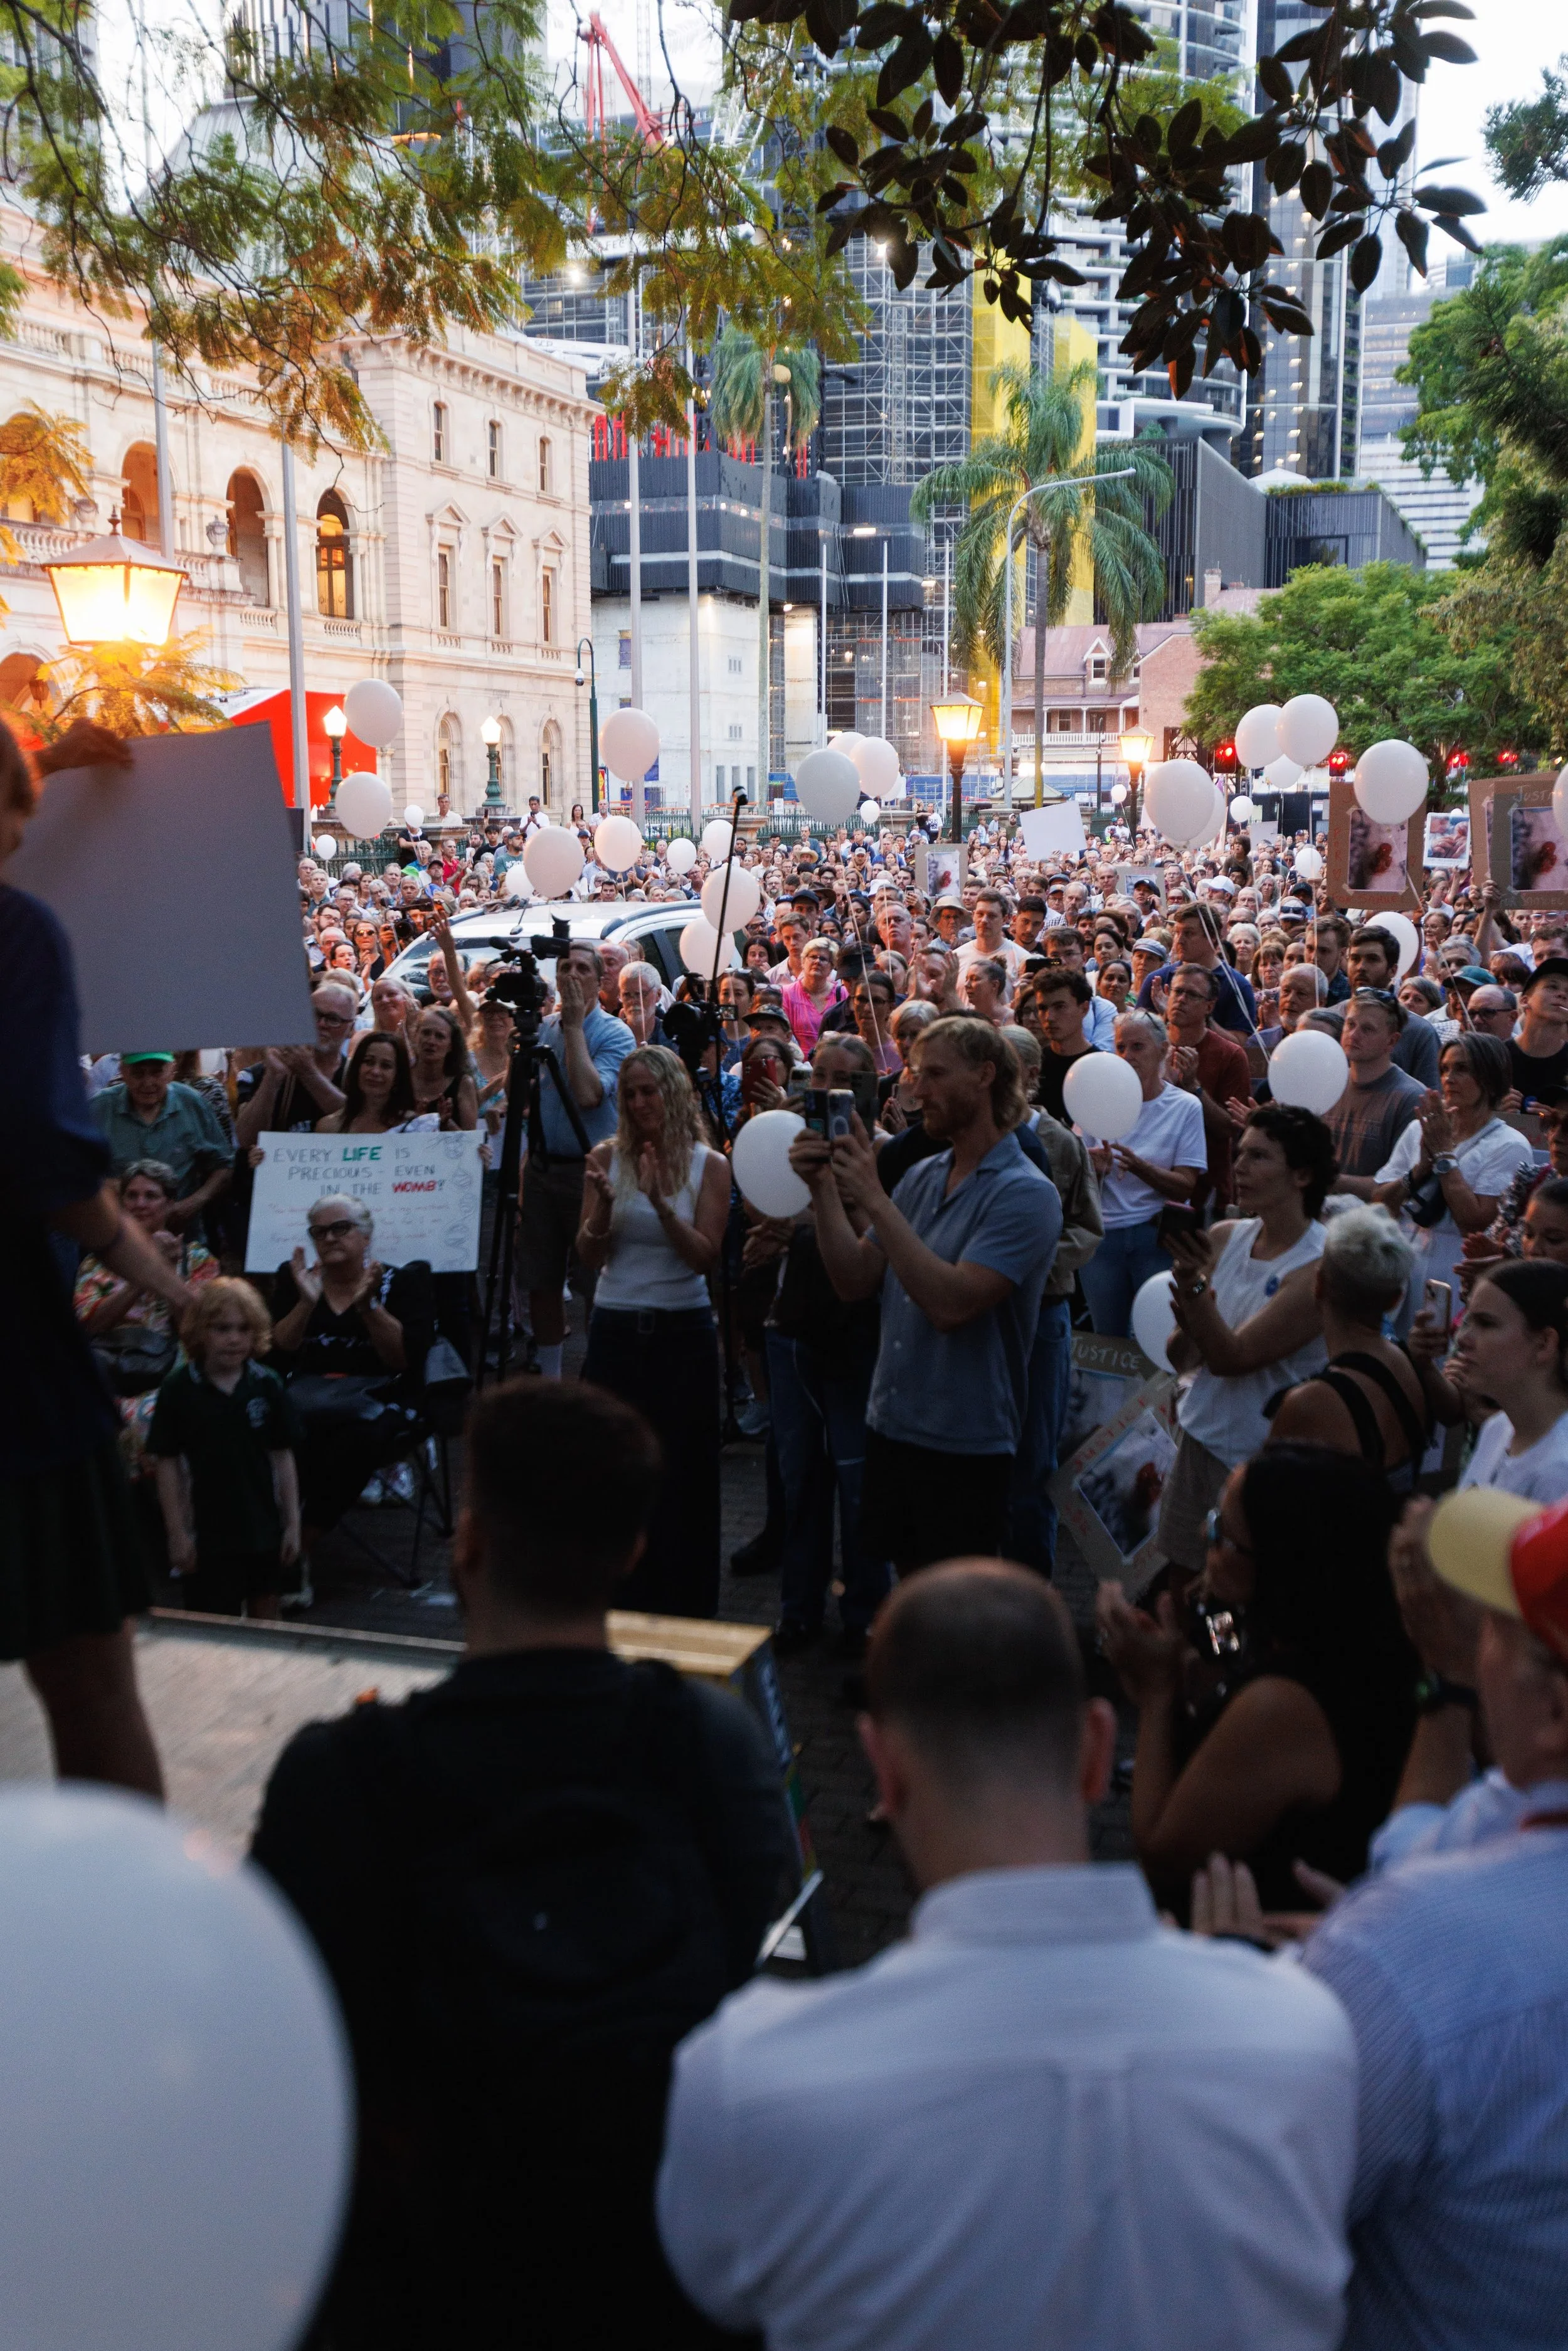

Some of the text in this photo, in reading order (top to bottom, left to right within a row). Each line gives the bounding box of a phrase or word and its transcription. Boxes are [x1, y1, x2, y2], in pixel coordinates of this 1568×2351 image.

[273, 1146, 410, 1163] EVERY LIFE IS
[287, 1165, 373, 1181] PRECIOUS
[395, 1164, 436, 1177] EVEN
[320, 1183, 341, 1196] IN
[351, 1182, 383, 1195] THE
[1071, 1336, 1142, 1369] JUSTICE
